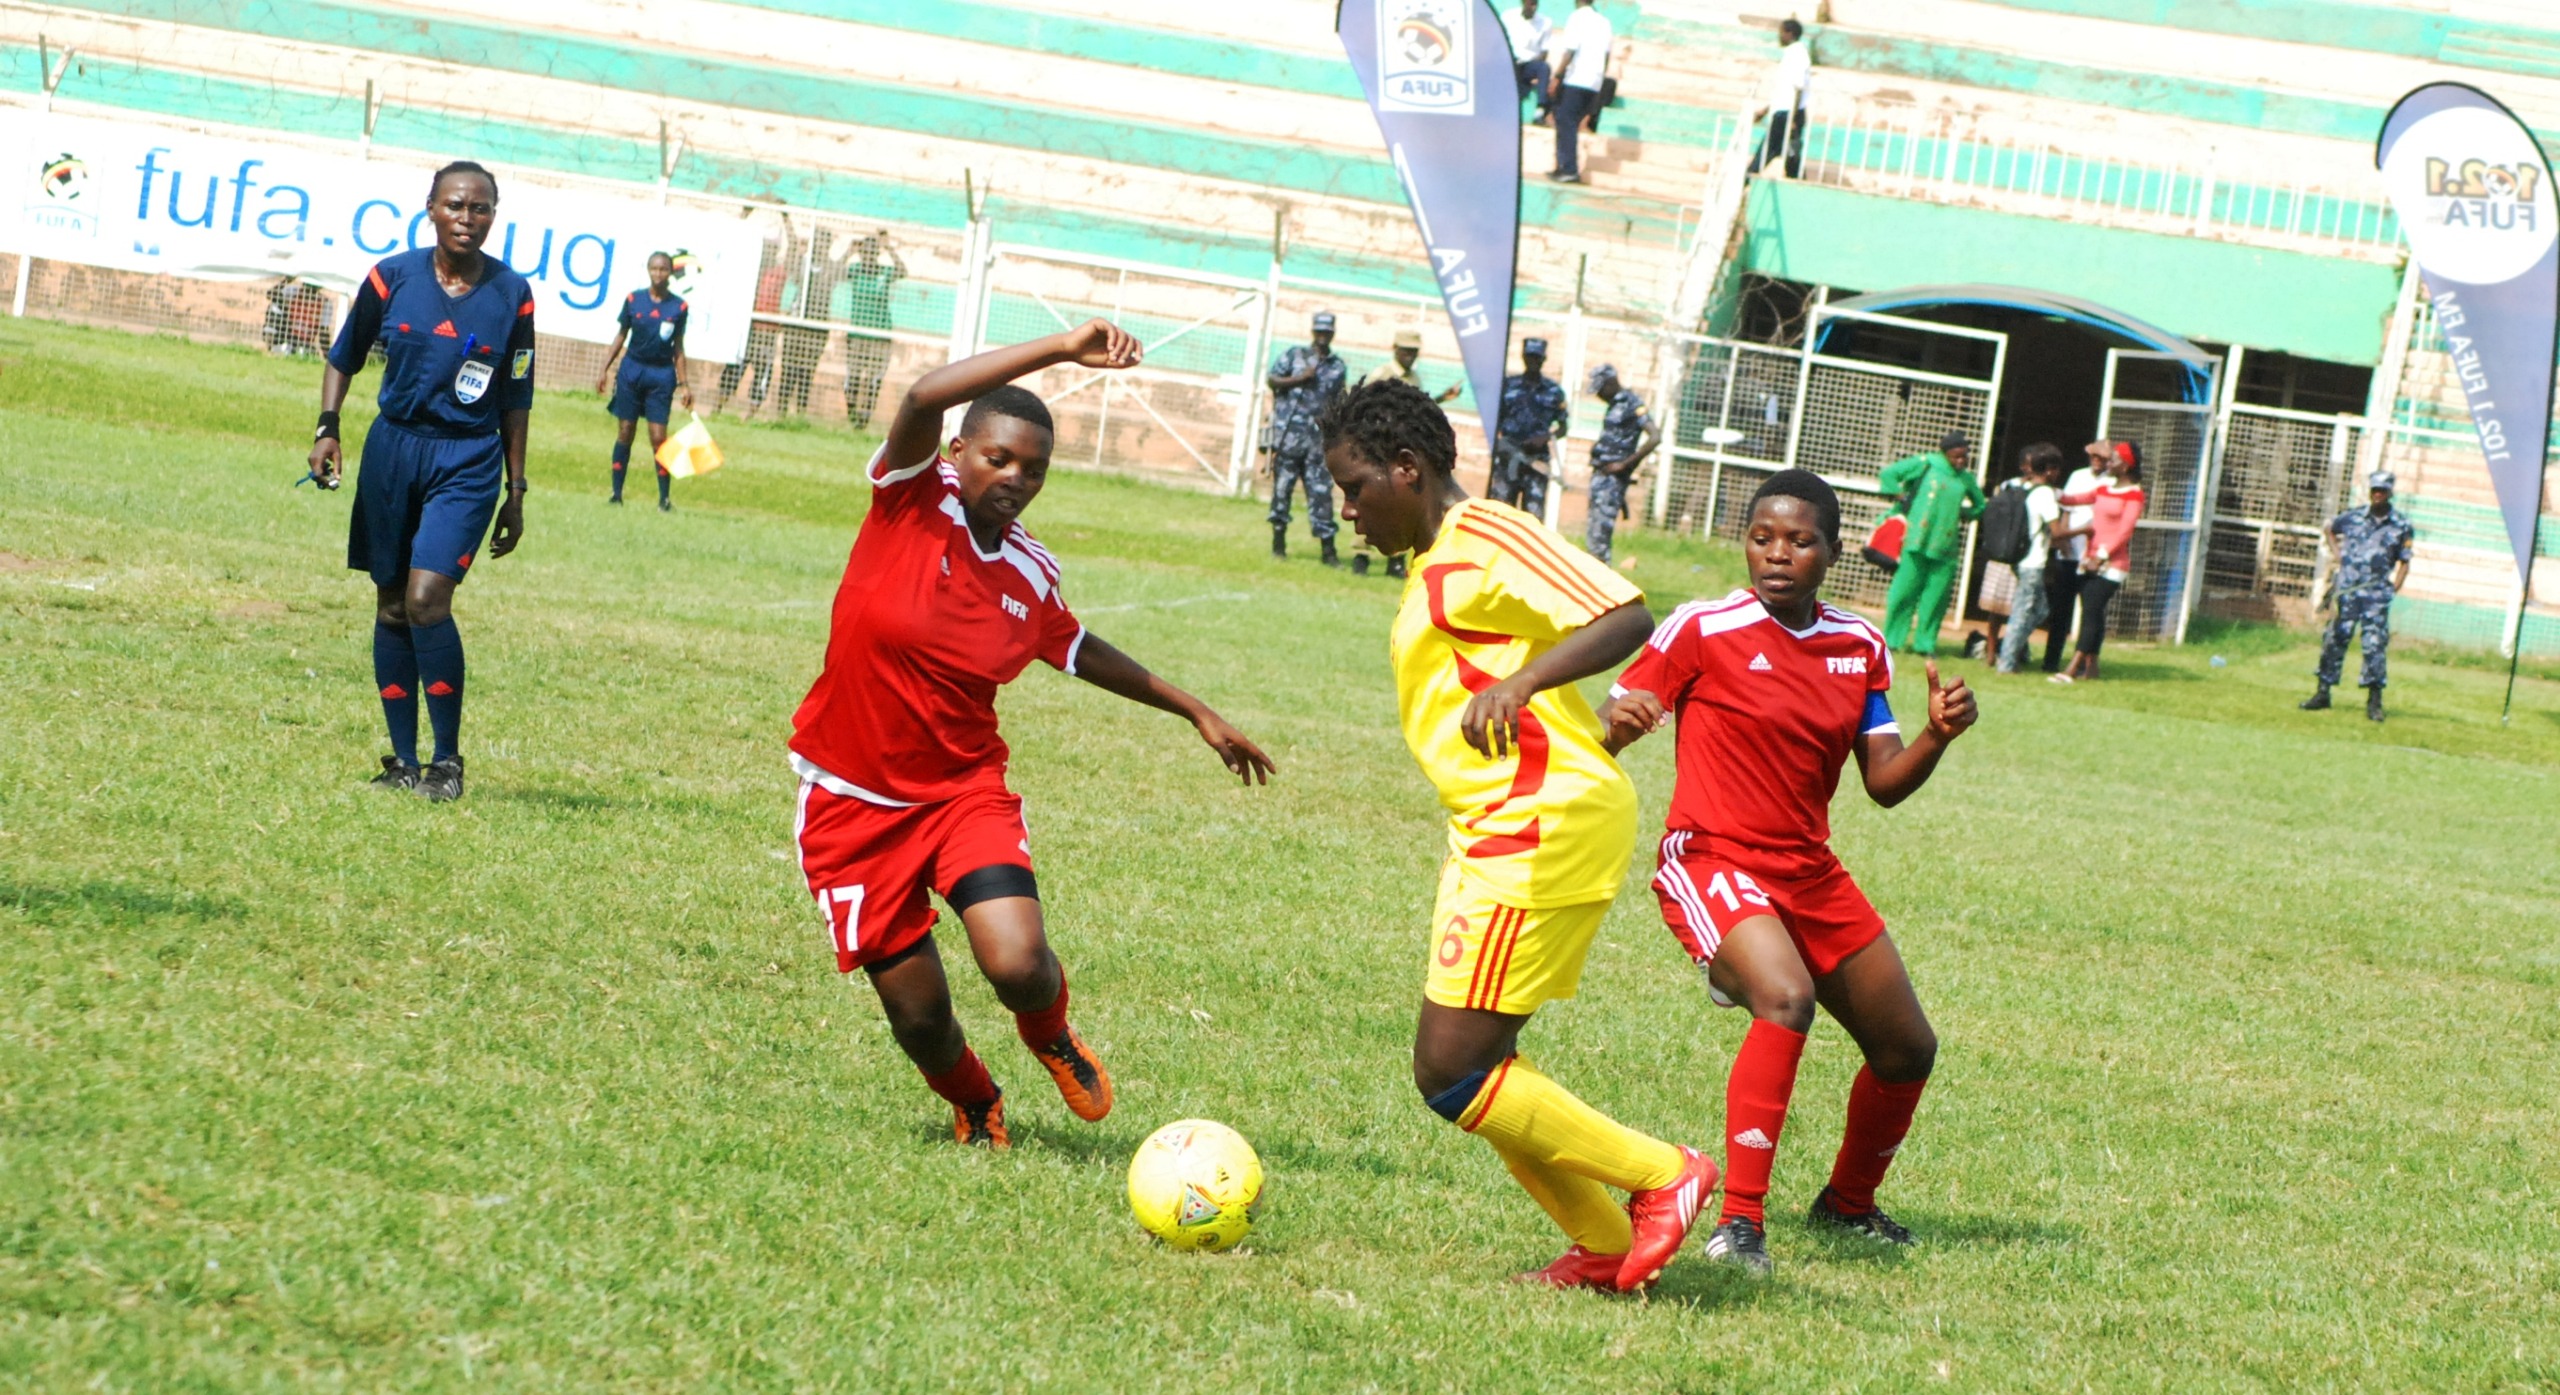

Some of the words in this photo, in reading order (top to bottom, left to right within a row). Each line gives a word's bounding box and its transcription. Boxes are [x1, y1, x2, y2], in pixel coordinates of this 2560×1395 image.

[136, 147, 616, 311] fufa.cug
[460, 374, 482, 390] FIFA
[1001, 593, 1028, 622] FIFA
[1826, 656, 1867, 674] FIFA
[1706, 870, 1770, 912] 15
[818, 884, 865, 953] 17
[1438, 914, 1469, 967] 6
